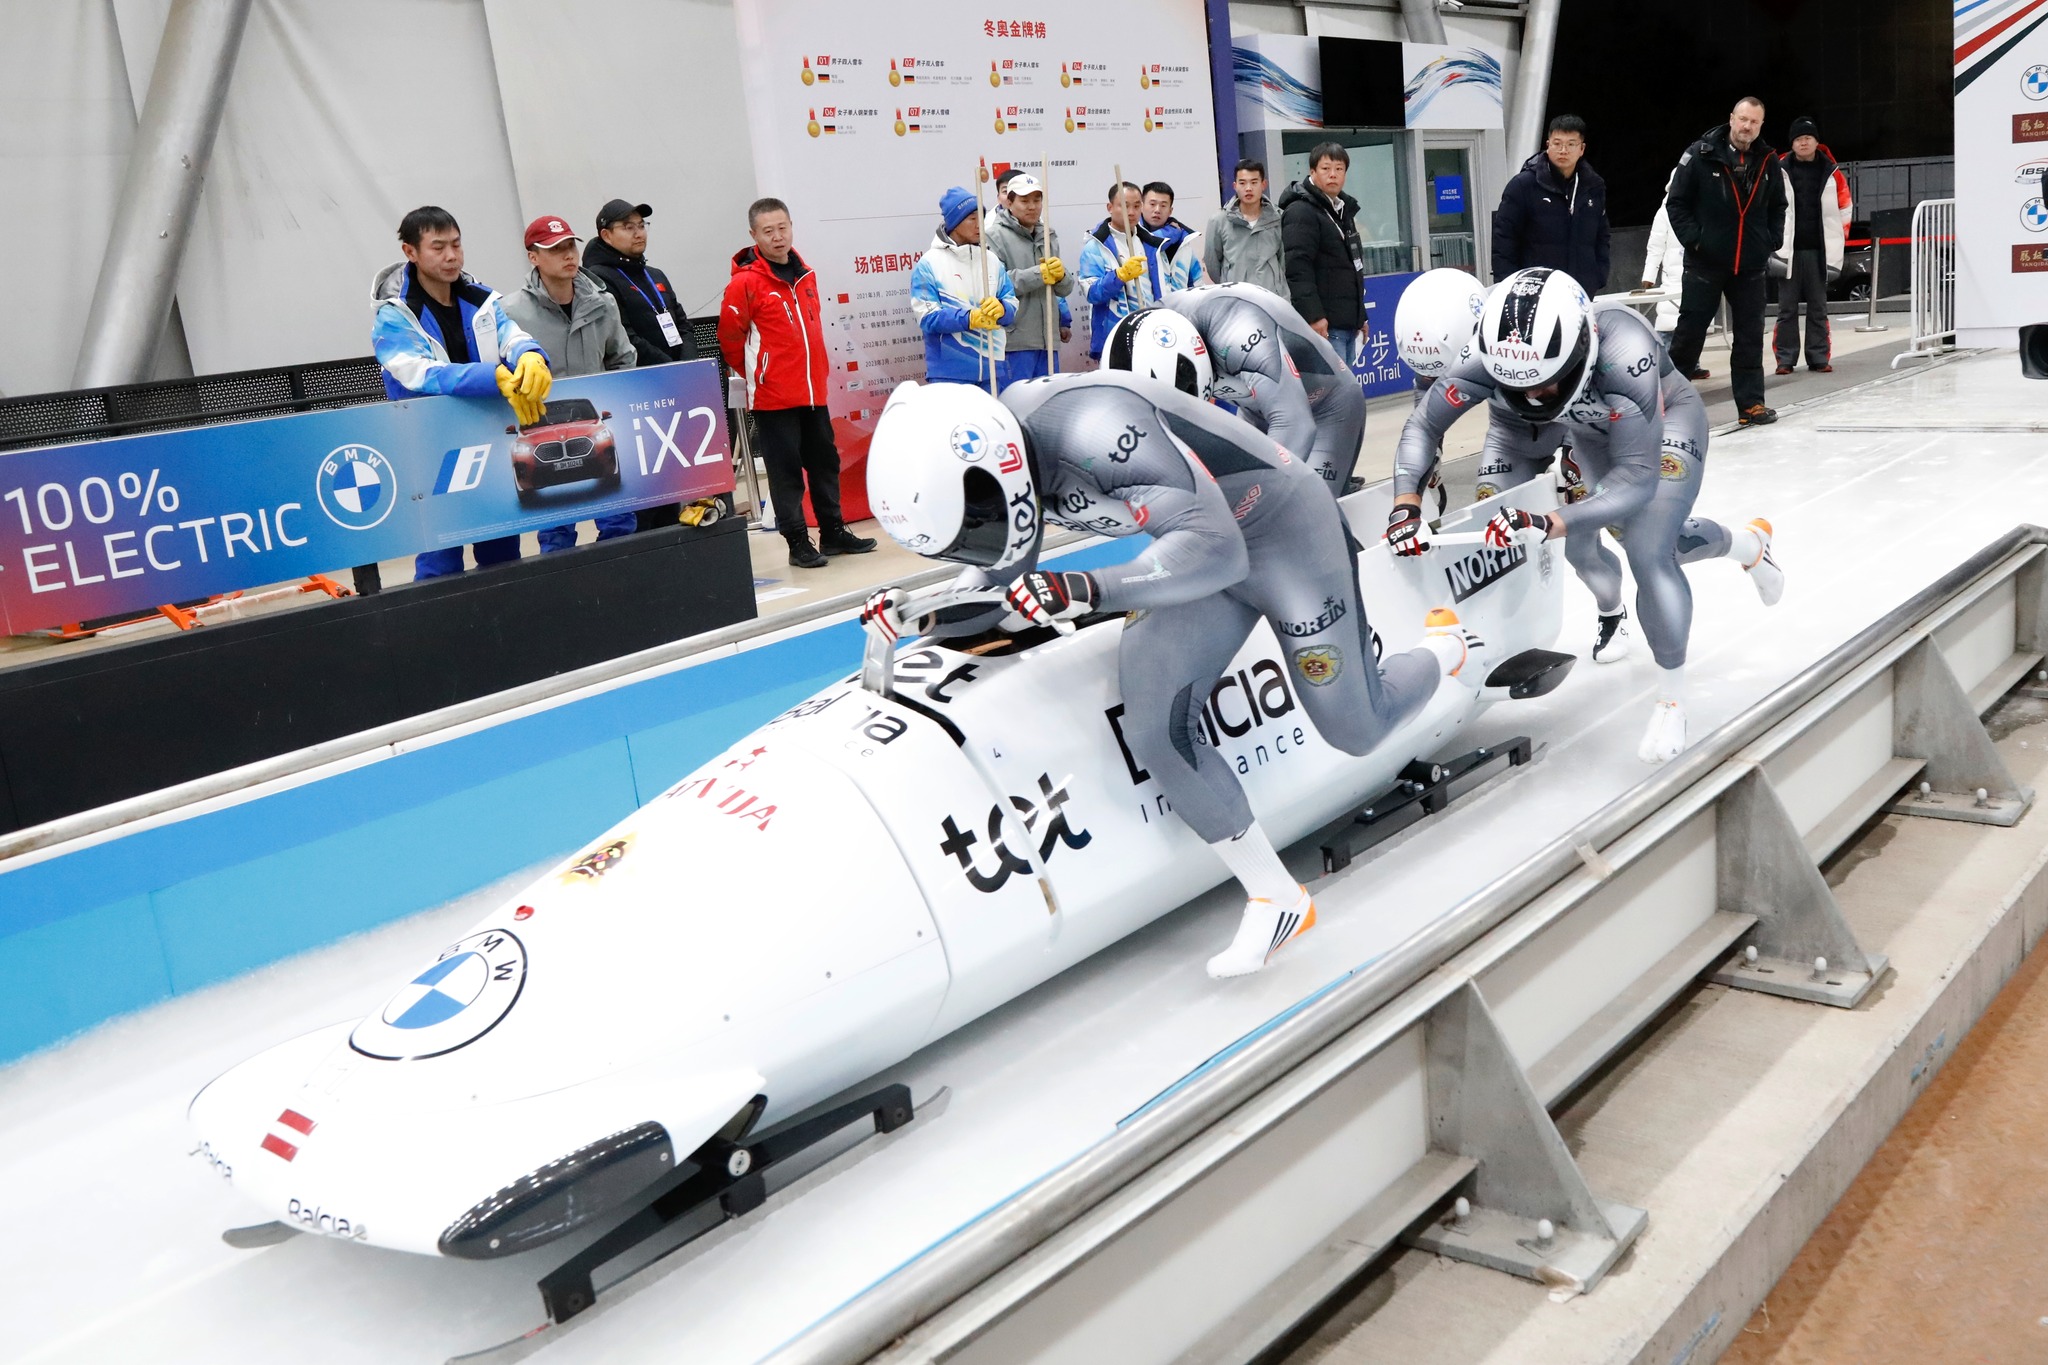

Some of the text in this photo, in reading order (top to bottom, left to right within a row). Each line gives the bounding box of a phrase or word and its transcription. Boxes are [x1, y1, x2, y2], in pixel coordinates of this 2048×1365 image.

[984, 19, 1046, 39] 冬奥金牌榜
[1240, 328, 1268, 354] tet
[1406, 344, 1441, 356] ATVIJA
[1489, 345, 1540, 362] LATVIJA
[1377, 362, 1401, 382] Trail
[1493, 363, 1541, 381] Balcia
[629, 398, 676, 413] THE NEW
[632, 406, 724, 476] iX2
[1108, 424, 1148, 464] tet
[4, 468, 180, 535] 100%
[1389, 524, 1415, 543] SEIZ
[22, 503, 308, 594] ELECTRIC
[1450, 542, 1528, 600] NORFIN
[1029, 573, 1054, 605] SEIZ
[666, 777, 778, 832] ATVIJA
[939, 771, 1093, 894] tet
